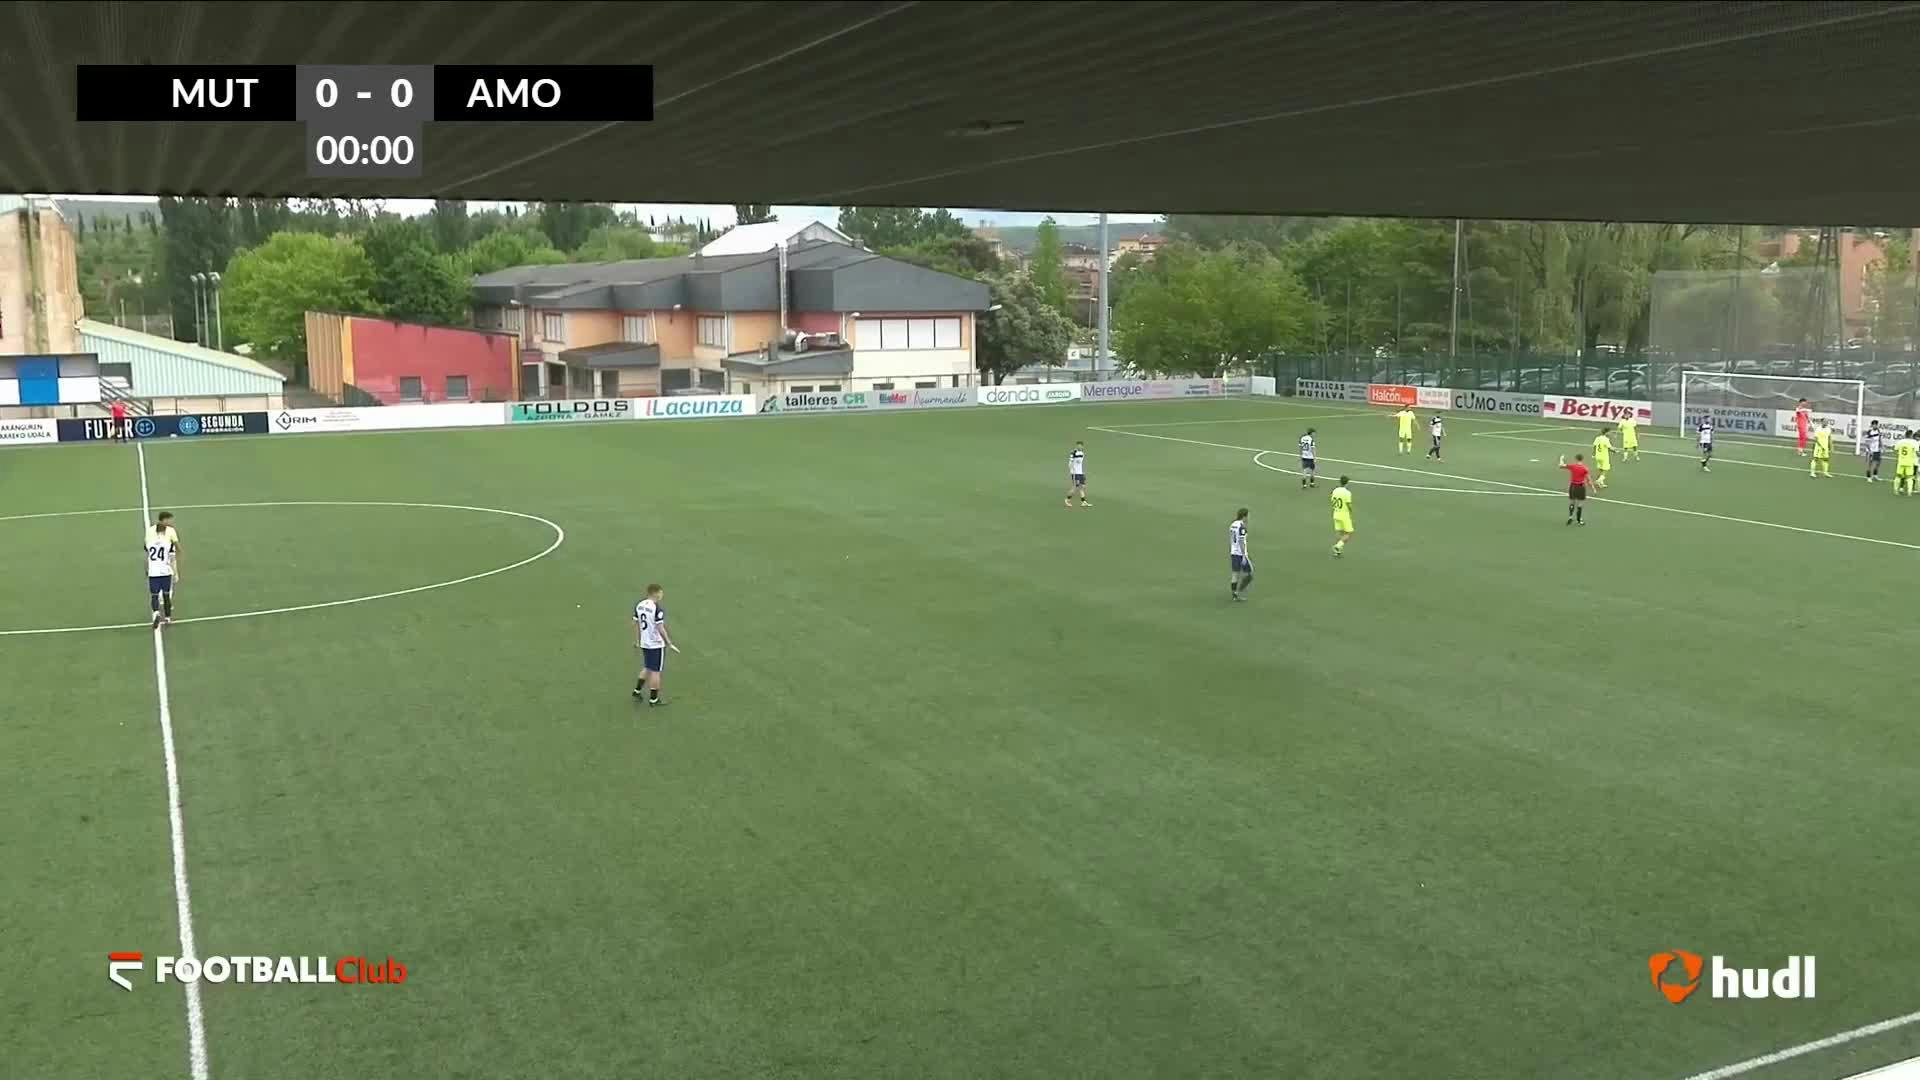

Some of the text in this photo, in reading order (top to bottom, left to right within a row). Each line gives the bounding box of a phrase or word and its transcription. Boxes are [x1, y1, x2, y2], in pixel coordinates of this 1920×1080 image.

[1083, 385, 1142, 398] Merengue
[1299, 381, 1345, 391] METALICAS
[785, 394, 838, 406] talleres
[986, 386, 1039, 403] denda
[1299, 389, 1345, 400] MUTILVA
[518, 401, 629, 415] TOLDOS
[653, 398, 743, 416] Lacunza
[1500, 403, 1512, 412] en
[1515, 402, 1539, 413] casa
[1560, 398, 1634, 420] Berlys
[201, 415, 244, 428] SEGUNDA
[149, 546, 165, 561] 24
